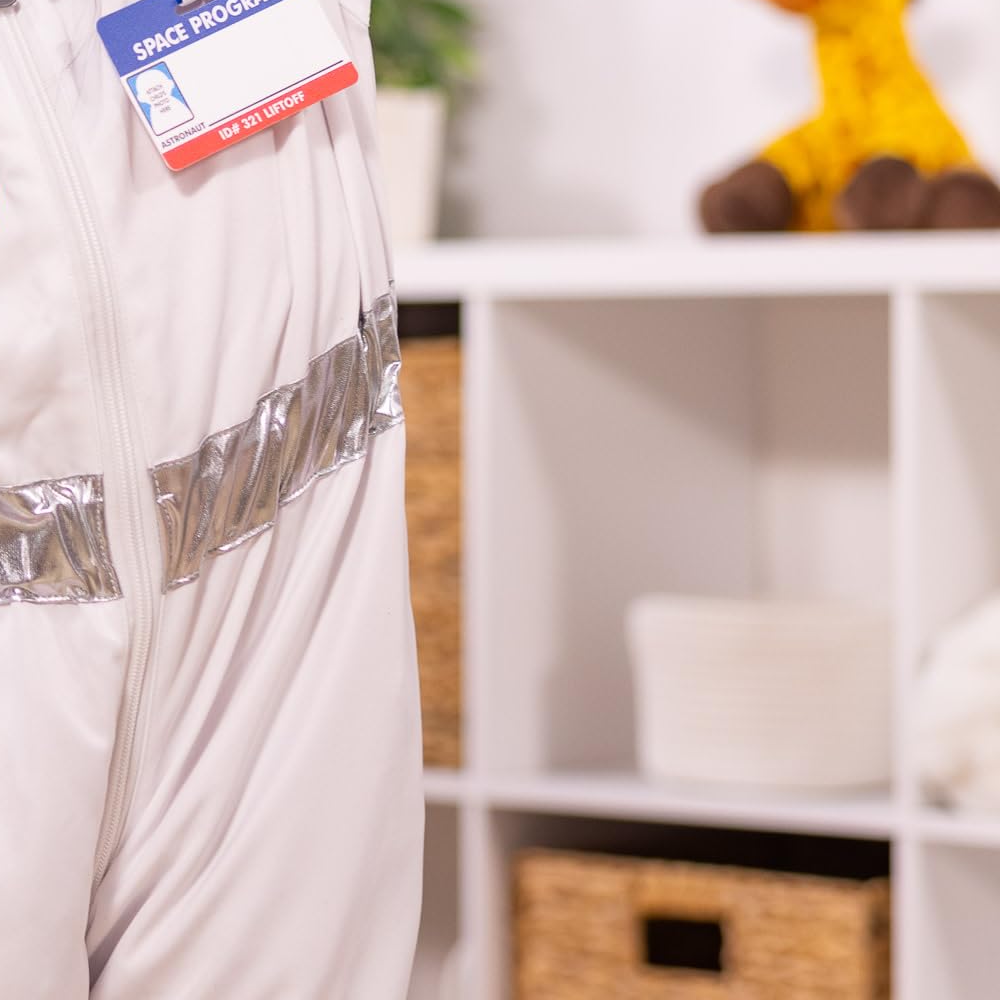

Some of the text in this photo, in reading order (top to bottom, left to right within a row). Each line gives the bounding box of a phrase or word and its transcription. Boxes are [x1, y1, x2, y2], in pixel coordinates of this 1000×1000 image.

[133, 23, 189, 61] SPACE
[218, 91, 305, 141] ID# 321 LIFTOFF
[161, 122, 207, 149] ASTRONAUT
